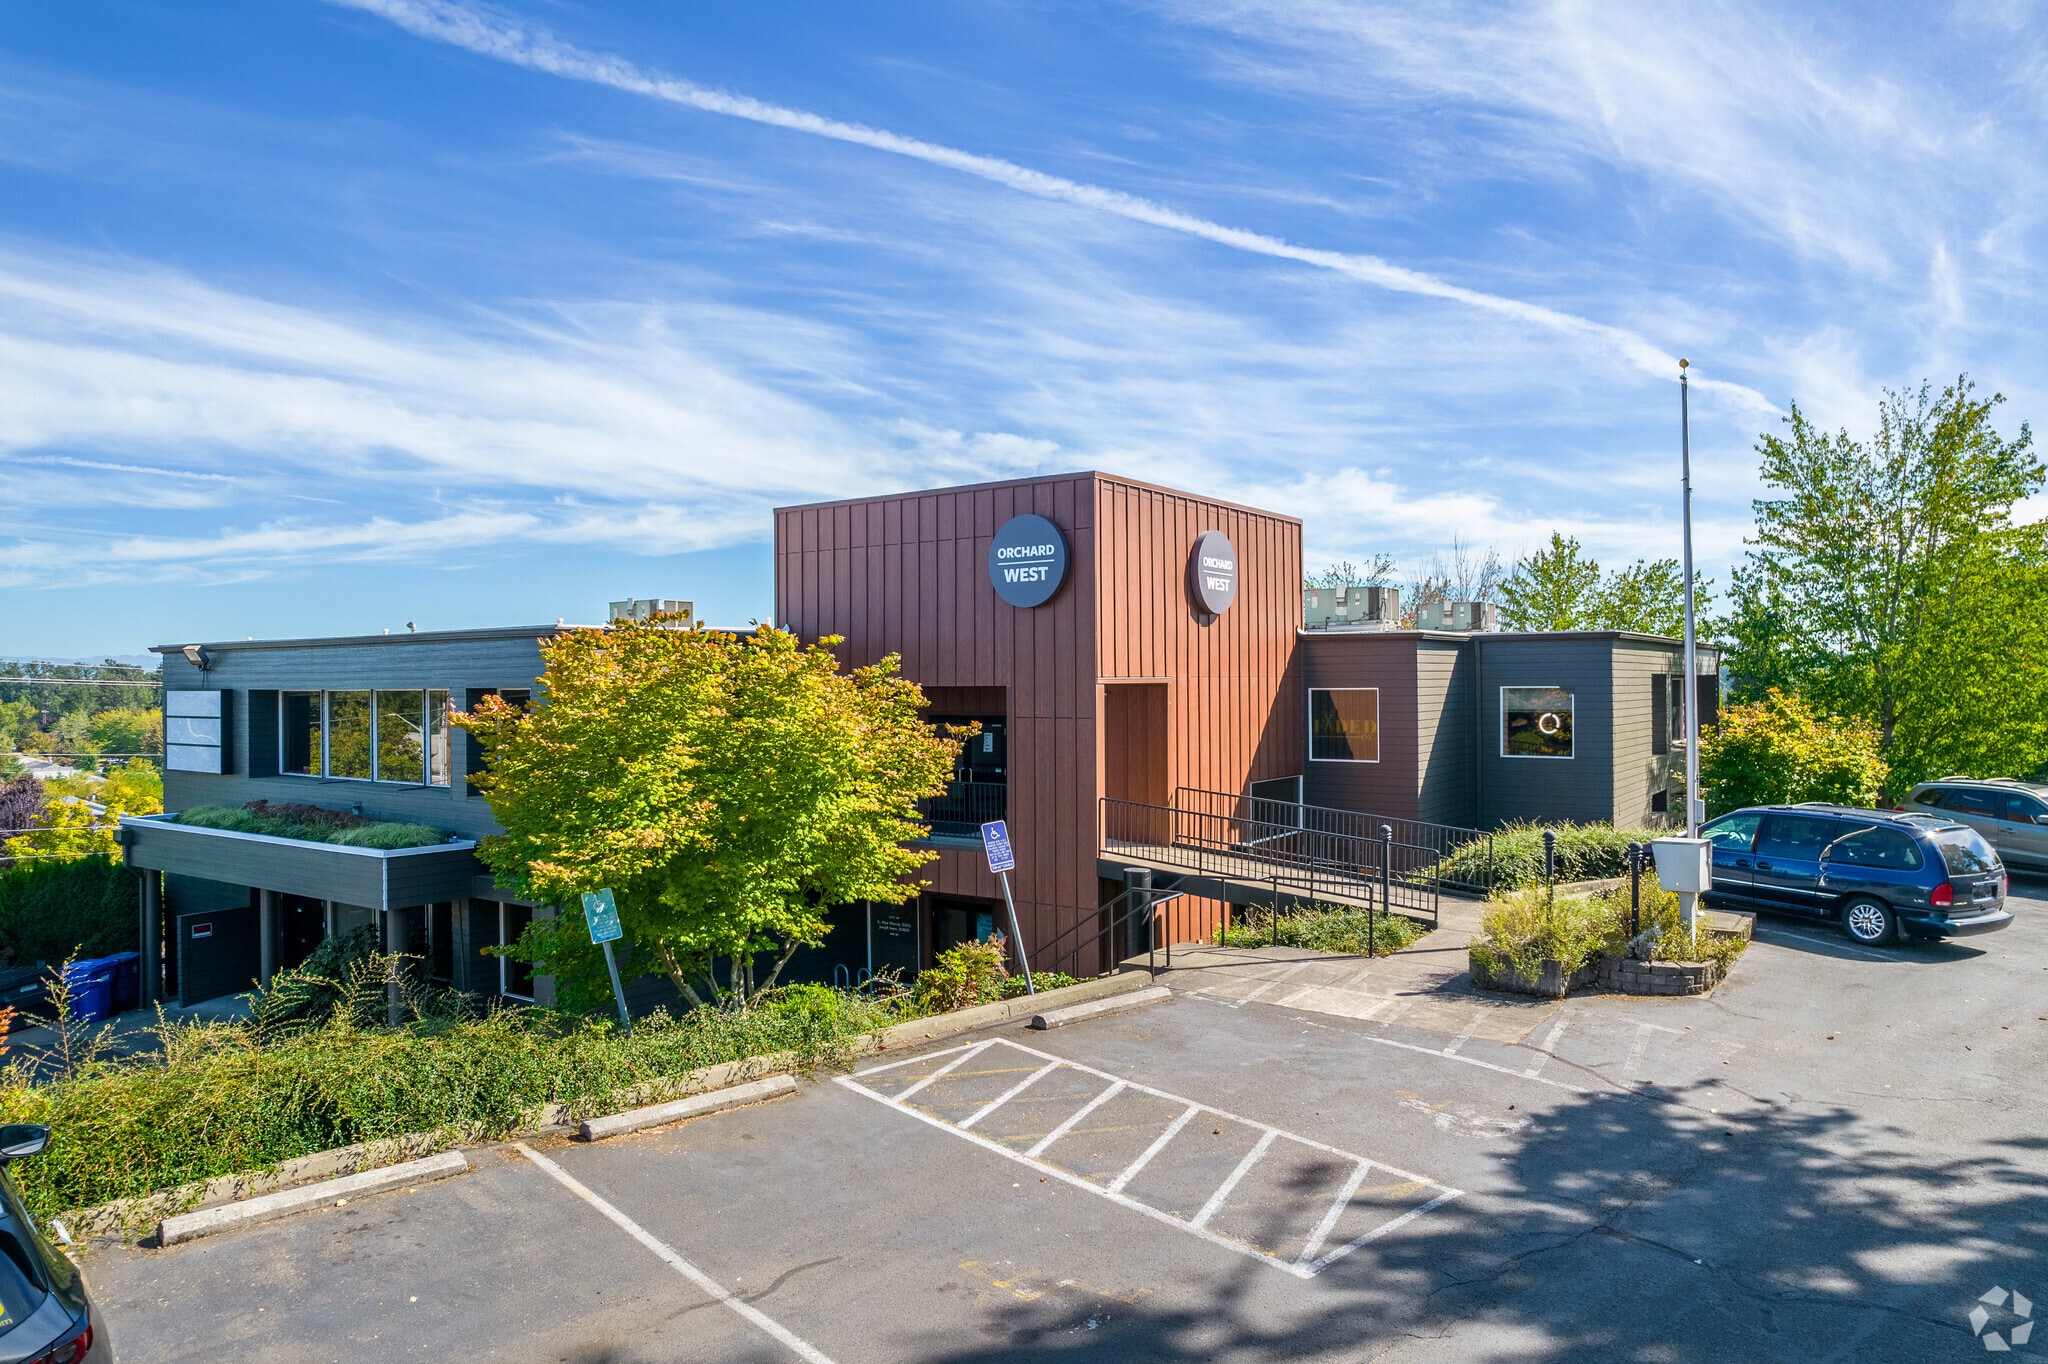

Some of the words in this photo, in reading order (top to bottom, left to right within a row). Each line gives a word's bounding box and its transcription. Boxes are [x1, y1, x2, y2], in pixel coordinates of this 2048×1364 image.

[997, 544, 1055, 559] ORCHARD
[1203, 556, 1233, 570] ORCHARD
[1003, 566, 1048, 583] WEST
[1206, 576, 1230, 592] WEST
